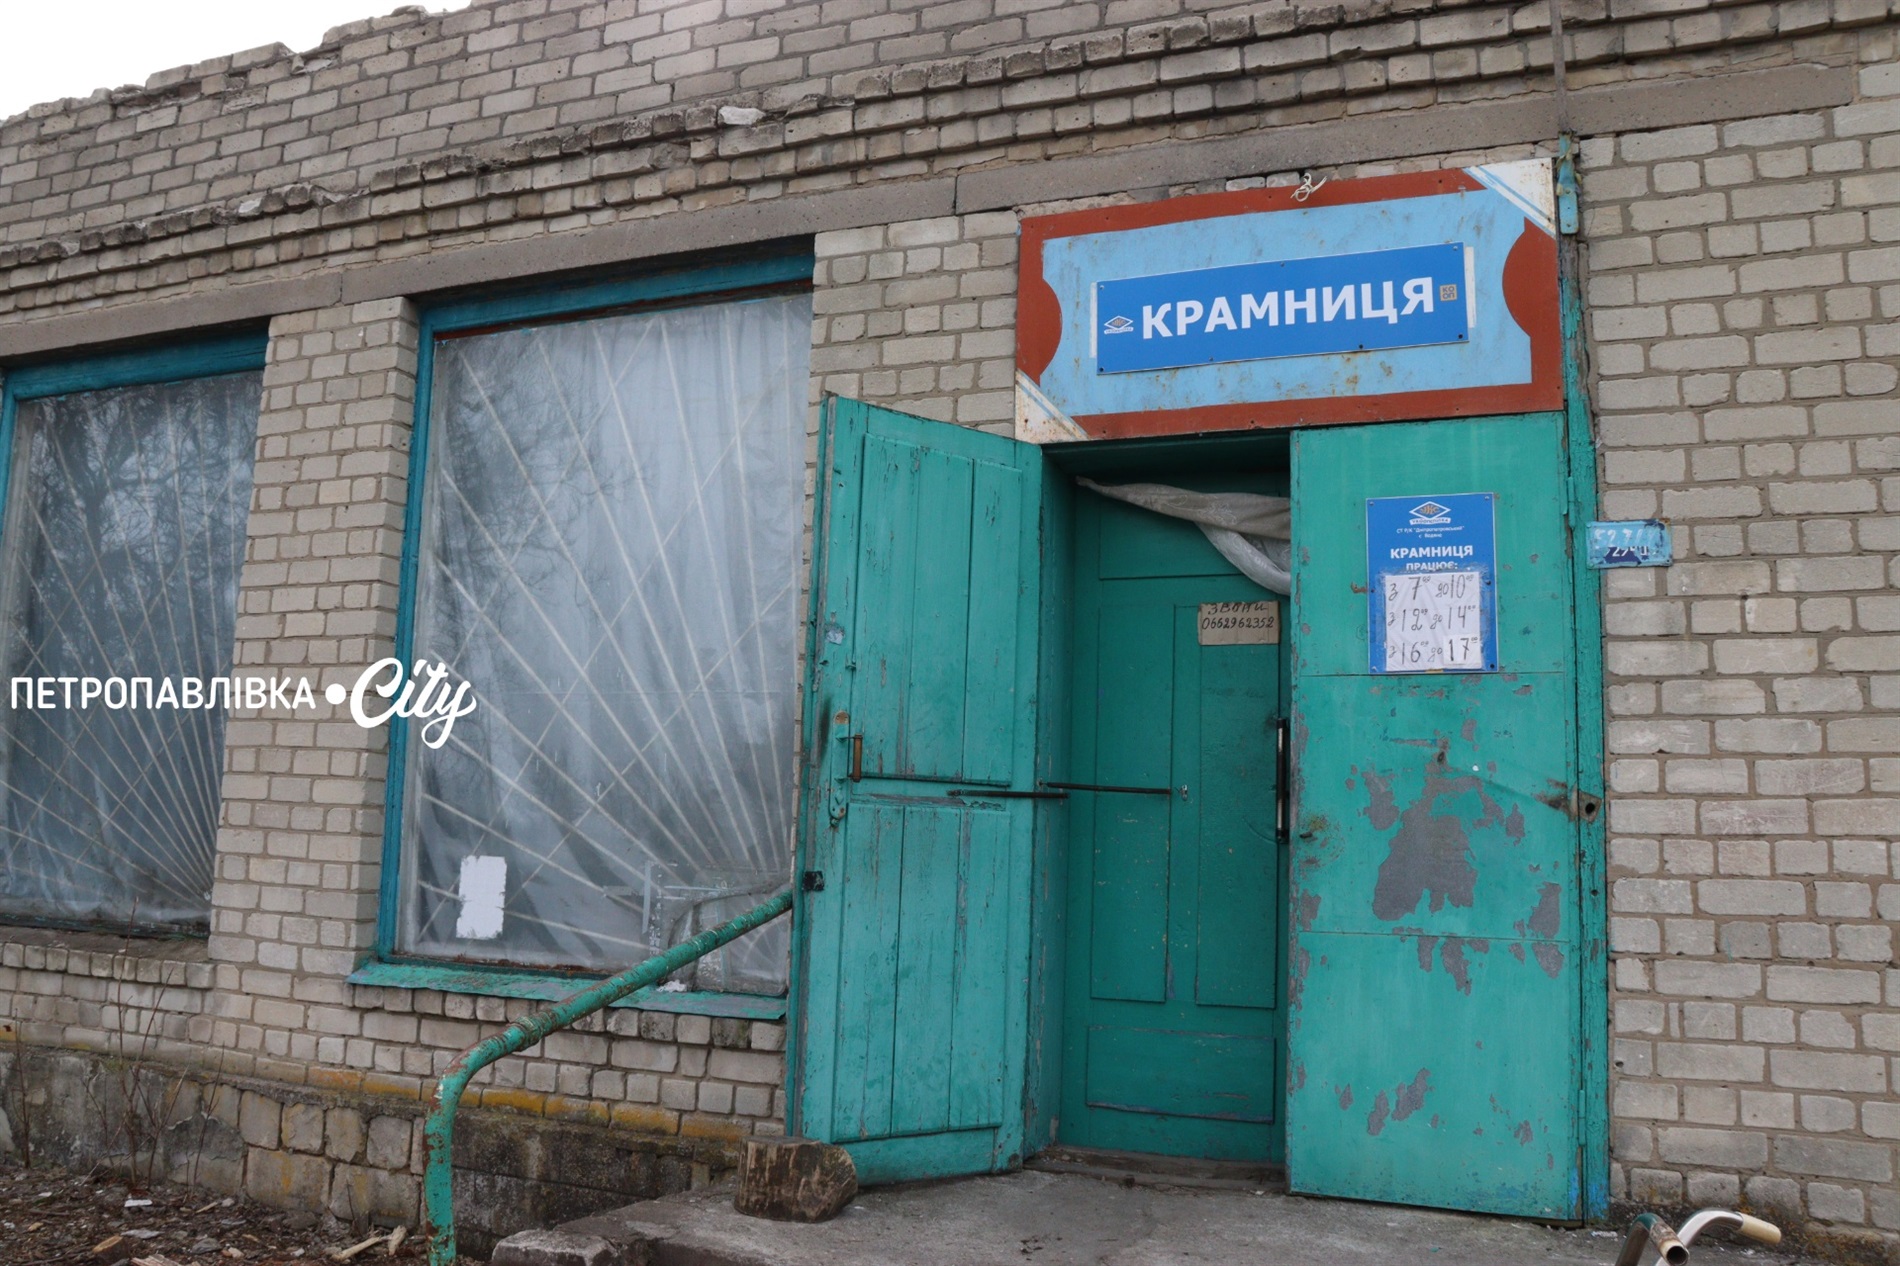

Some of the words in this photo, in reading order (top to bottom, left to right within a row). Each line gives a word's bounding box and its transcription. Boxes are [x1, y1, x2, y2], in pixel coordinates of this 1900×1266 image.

[1142, 277, 1434, 340] КРАМНИЦЯ
[1390, 545, 1473, 559] КРАМНИЦЯ
[1406, 561, 1458, 571] ПРАЦЮЄ:
[1201, 616, 1275, 630] 0662962352
